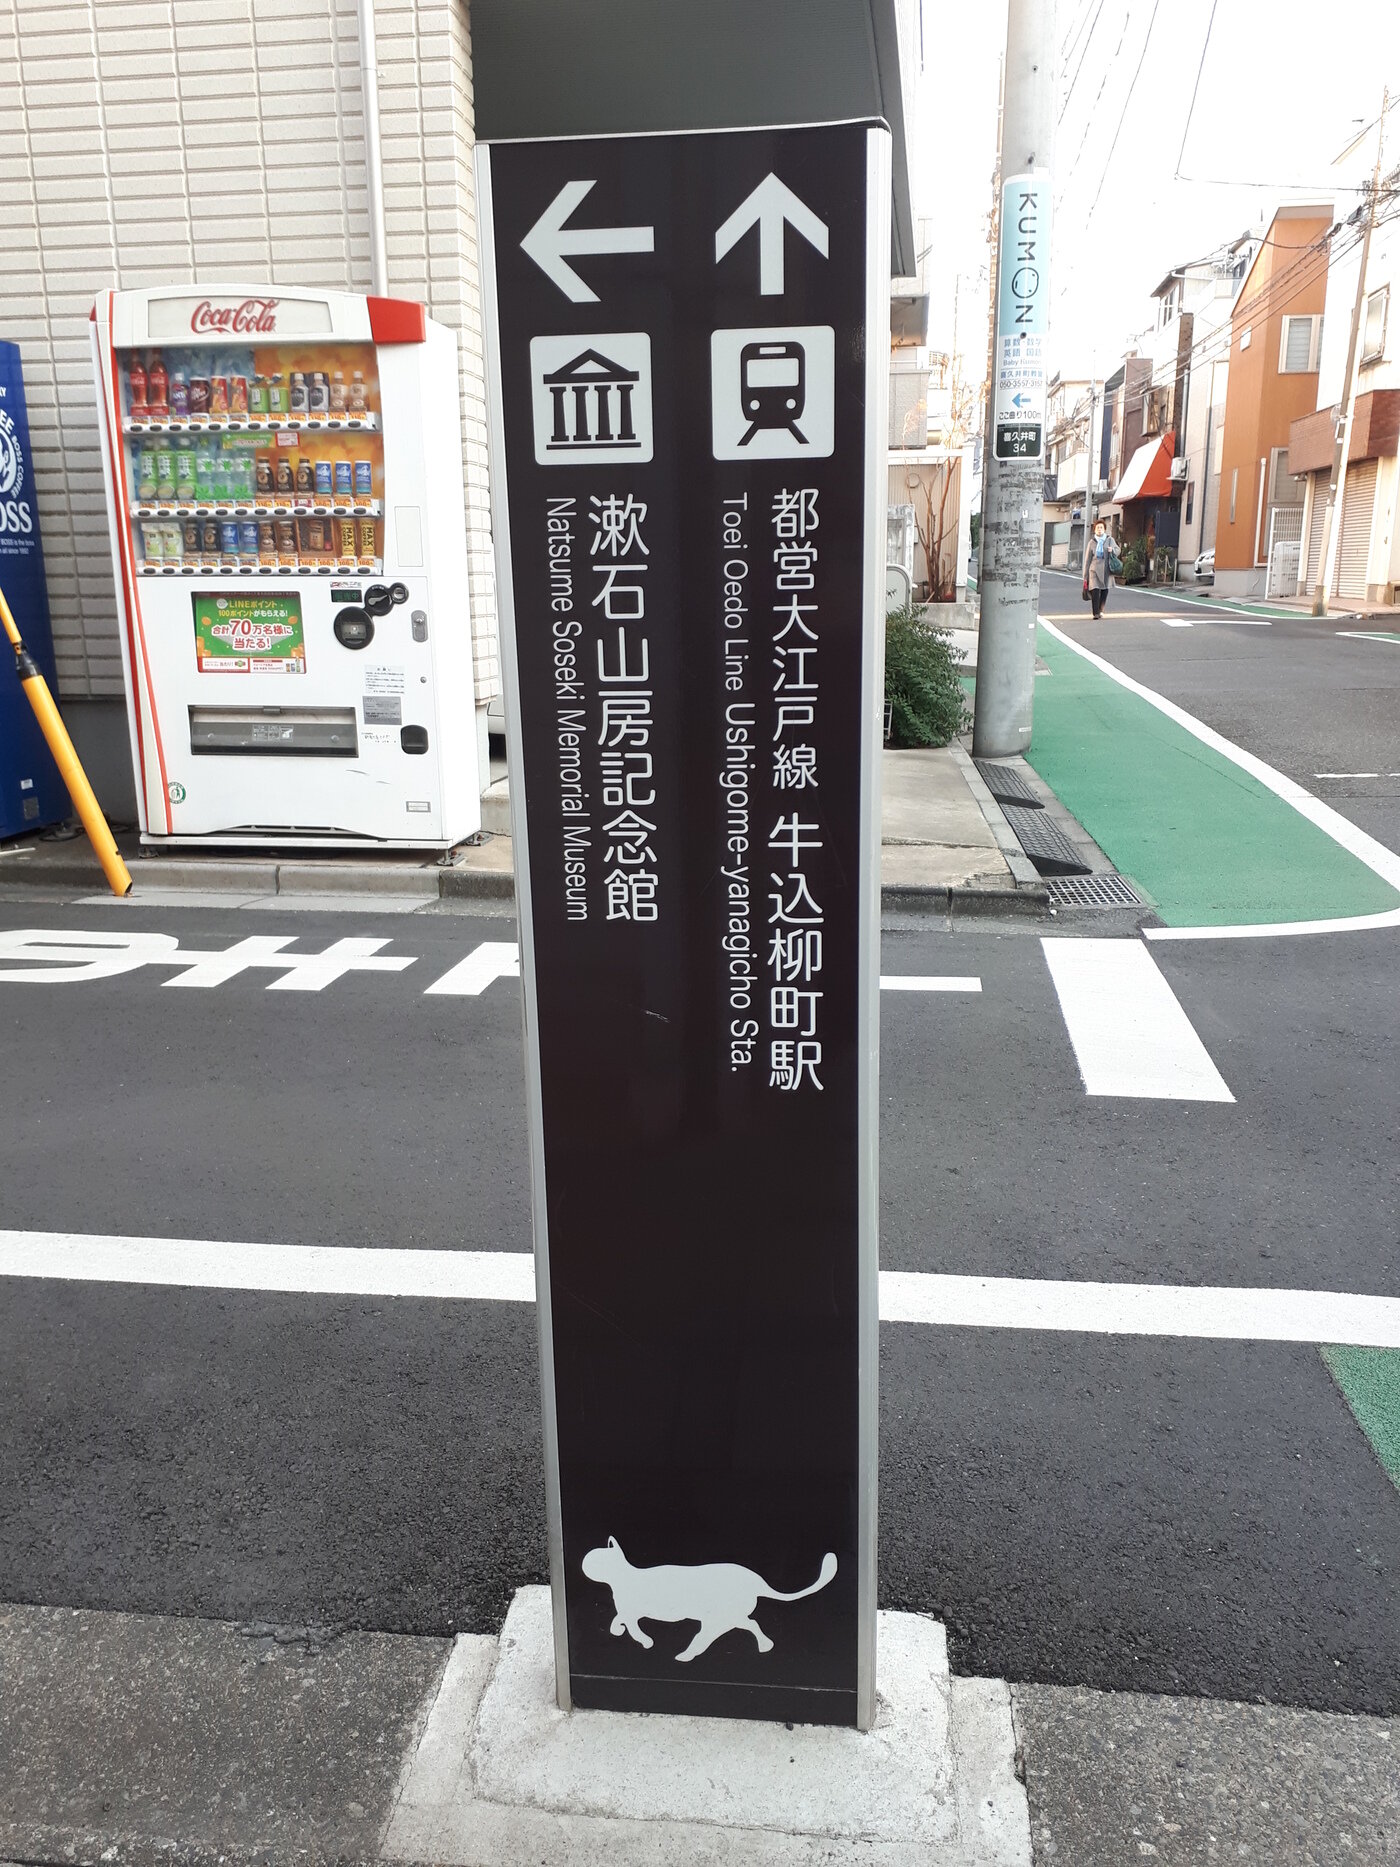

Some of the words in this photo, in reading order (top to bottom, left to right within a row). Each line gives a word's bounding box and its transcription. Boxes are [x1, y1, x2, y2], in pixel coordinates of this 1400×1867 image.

[1012, 193, 1039, 323] KUMON
[191, 298, 280, 334] Coca-Cola
[1003, 431, 1036, 442] 喜久井町
[1013, 443, 1027, 453] 34
[722, 492, 749, 550] Toei
[546, 496, 577, 613] Natsume
[218, 609, 288, 617] 100ポイントがもらえる!
[229, 601, 277, 609] LINEポイント
[723, 559, 749, 630] Oedo
[213, 619, 292, 636] 合計70万名様に
[234, 638, 271, 649] 当たる!
[771, 488, 820, 789] 都営大江戸線
[552, 621, 585, 700] Soseki
[724, 639, 750, 691] Line
[588, 493, 659, 922] 漱石山房記念館
[557, 709, 591, 817] Memorial
[562, 826, 592, 921] Museum
[719, 703, 758, 1009] Ushigome-yanagicho
[767, 812, 825, 1091] 牛込柳町駅
[730, 1019, 759, 1072] Sta.
